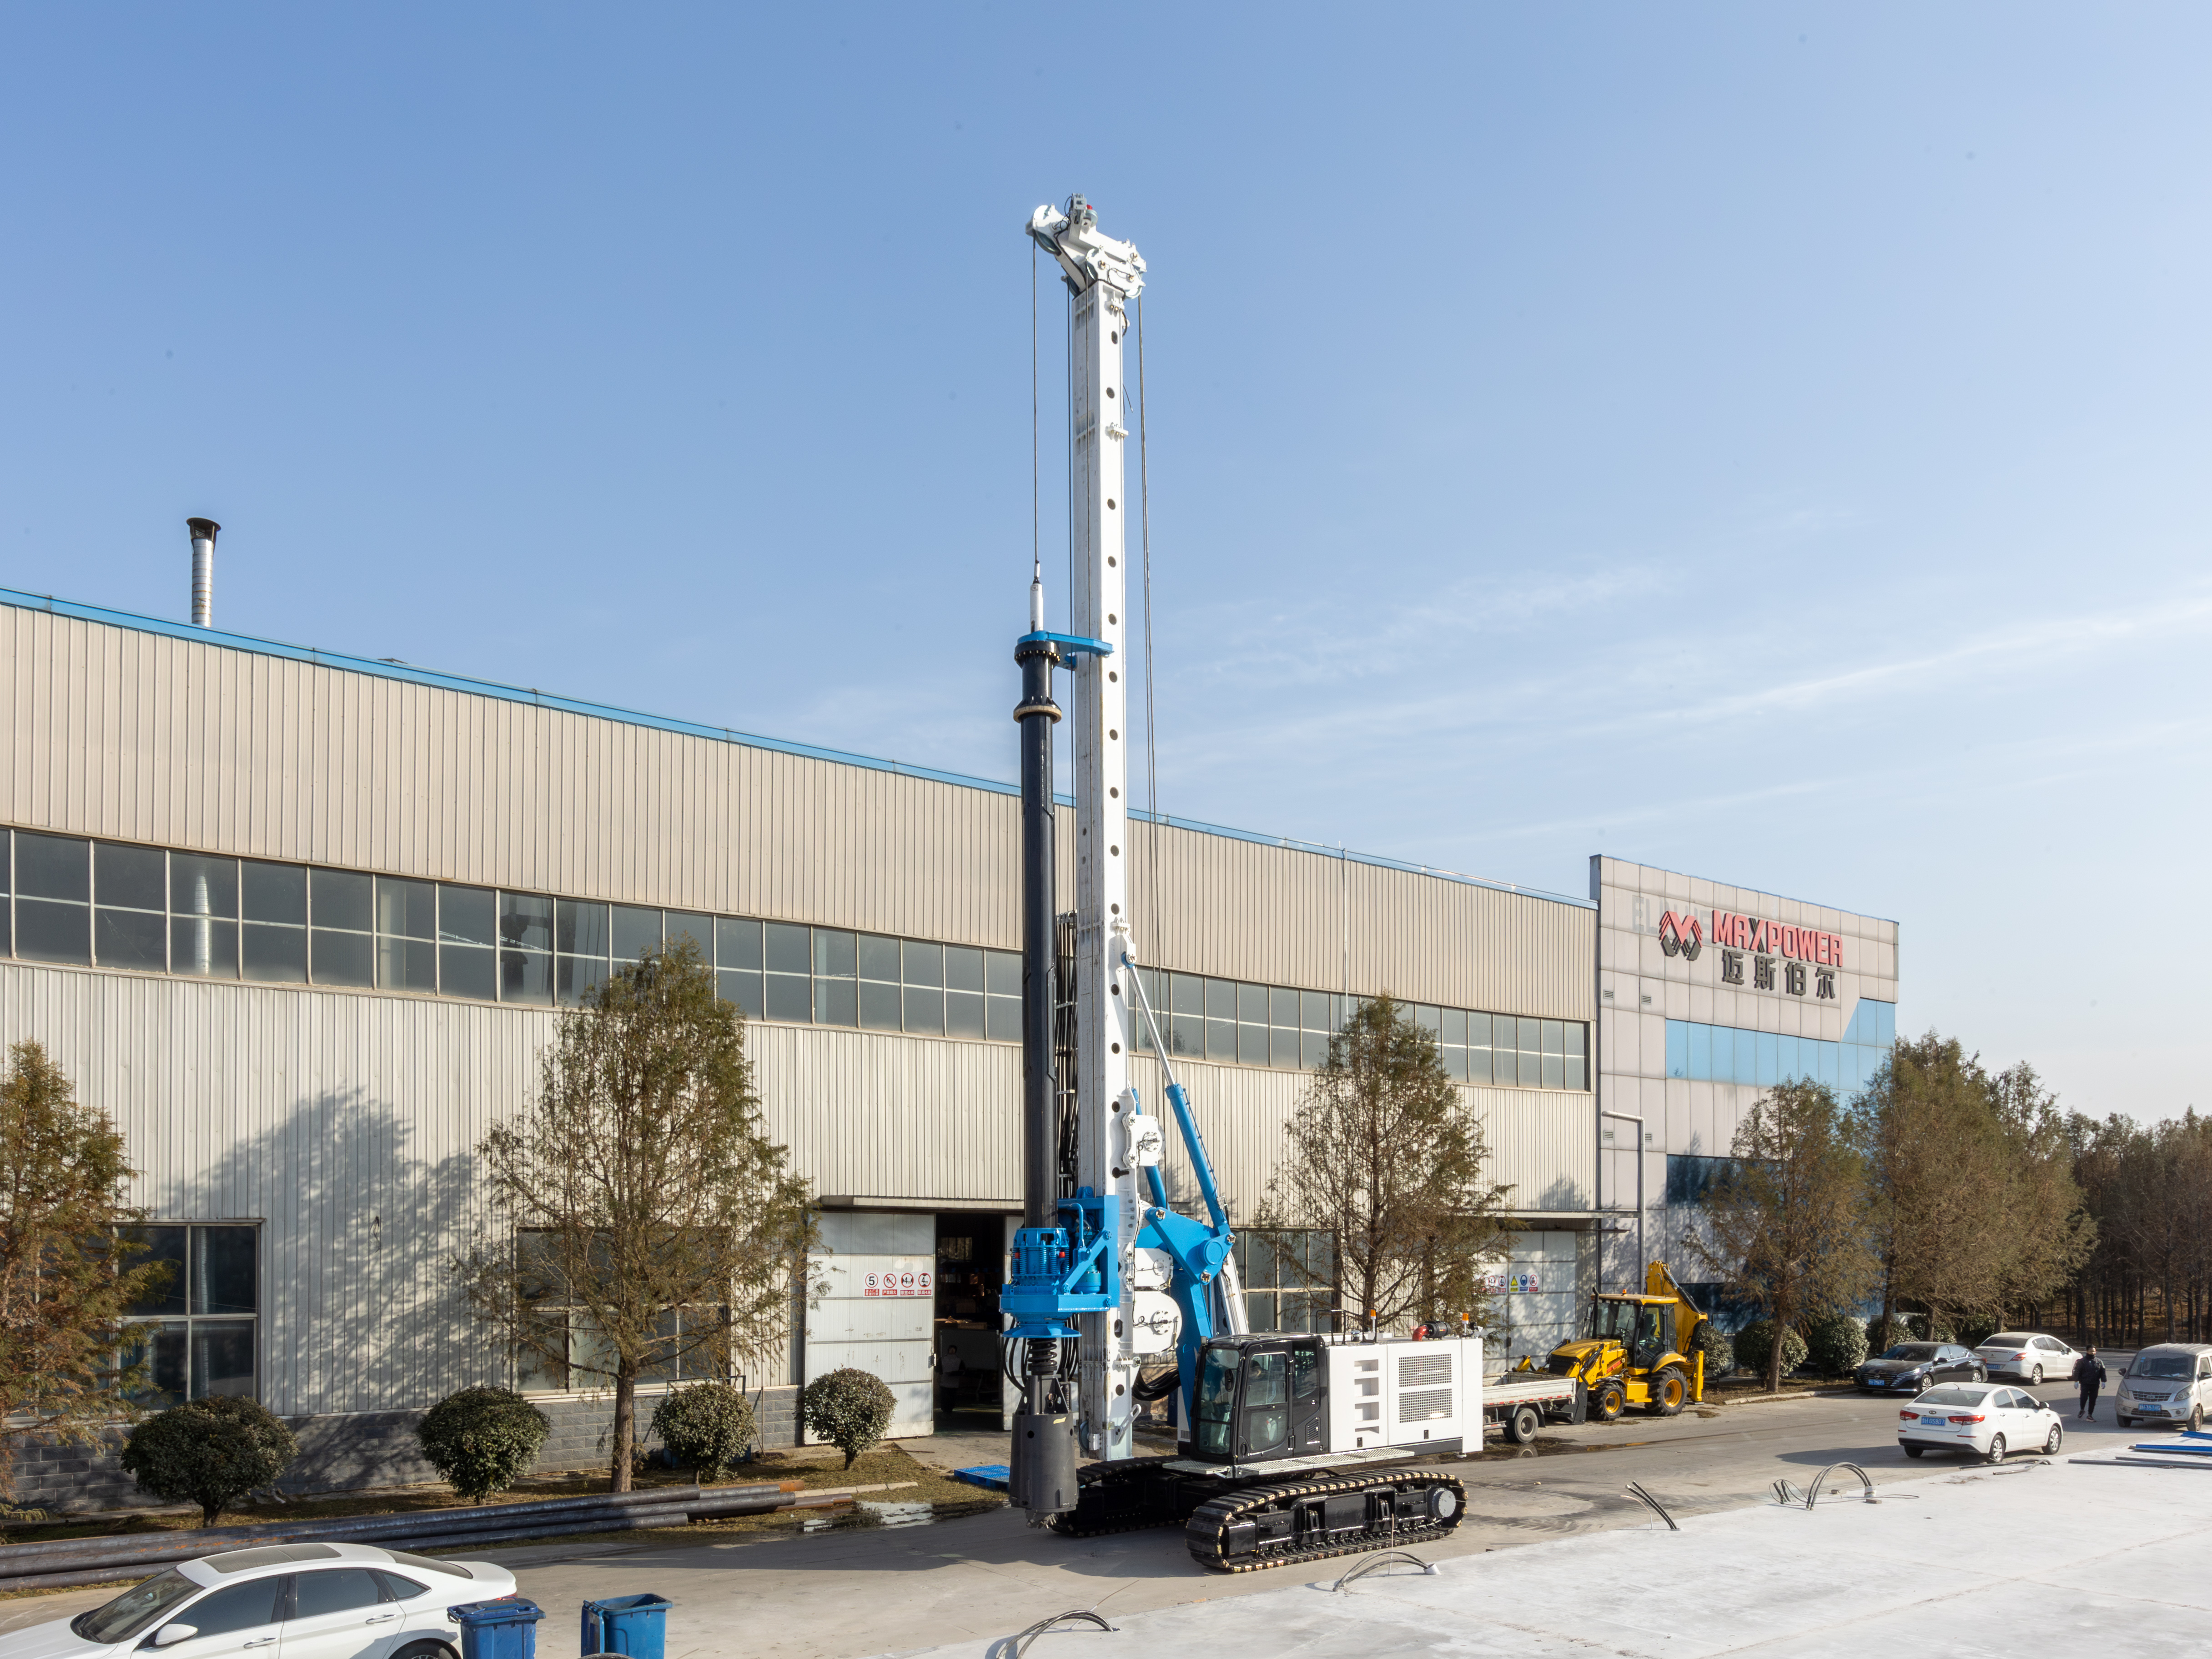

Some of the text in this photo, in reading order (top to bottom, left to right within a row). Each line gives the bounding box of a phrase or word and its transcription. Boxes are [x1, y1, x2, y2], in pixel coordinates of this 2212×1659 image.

[1712, 910, 1843, 967] MAXPOWER
[1722, 949, 1835, 999] 迈斯伯尔
[869, 1276, 875, 1286] 5
